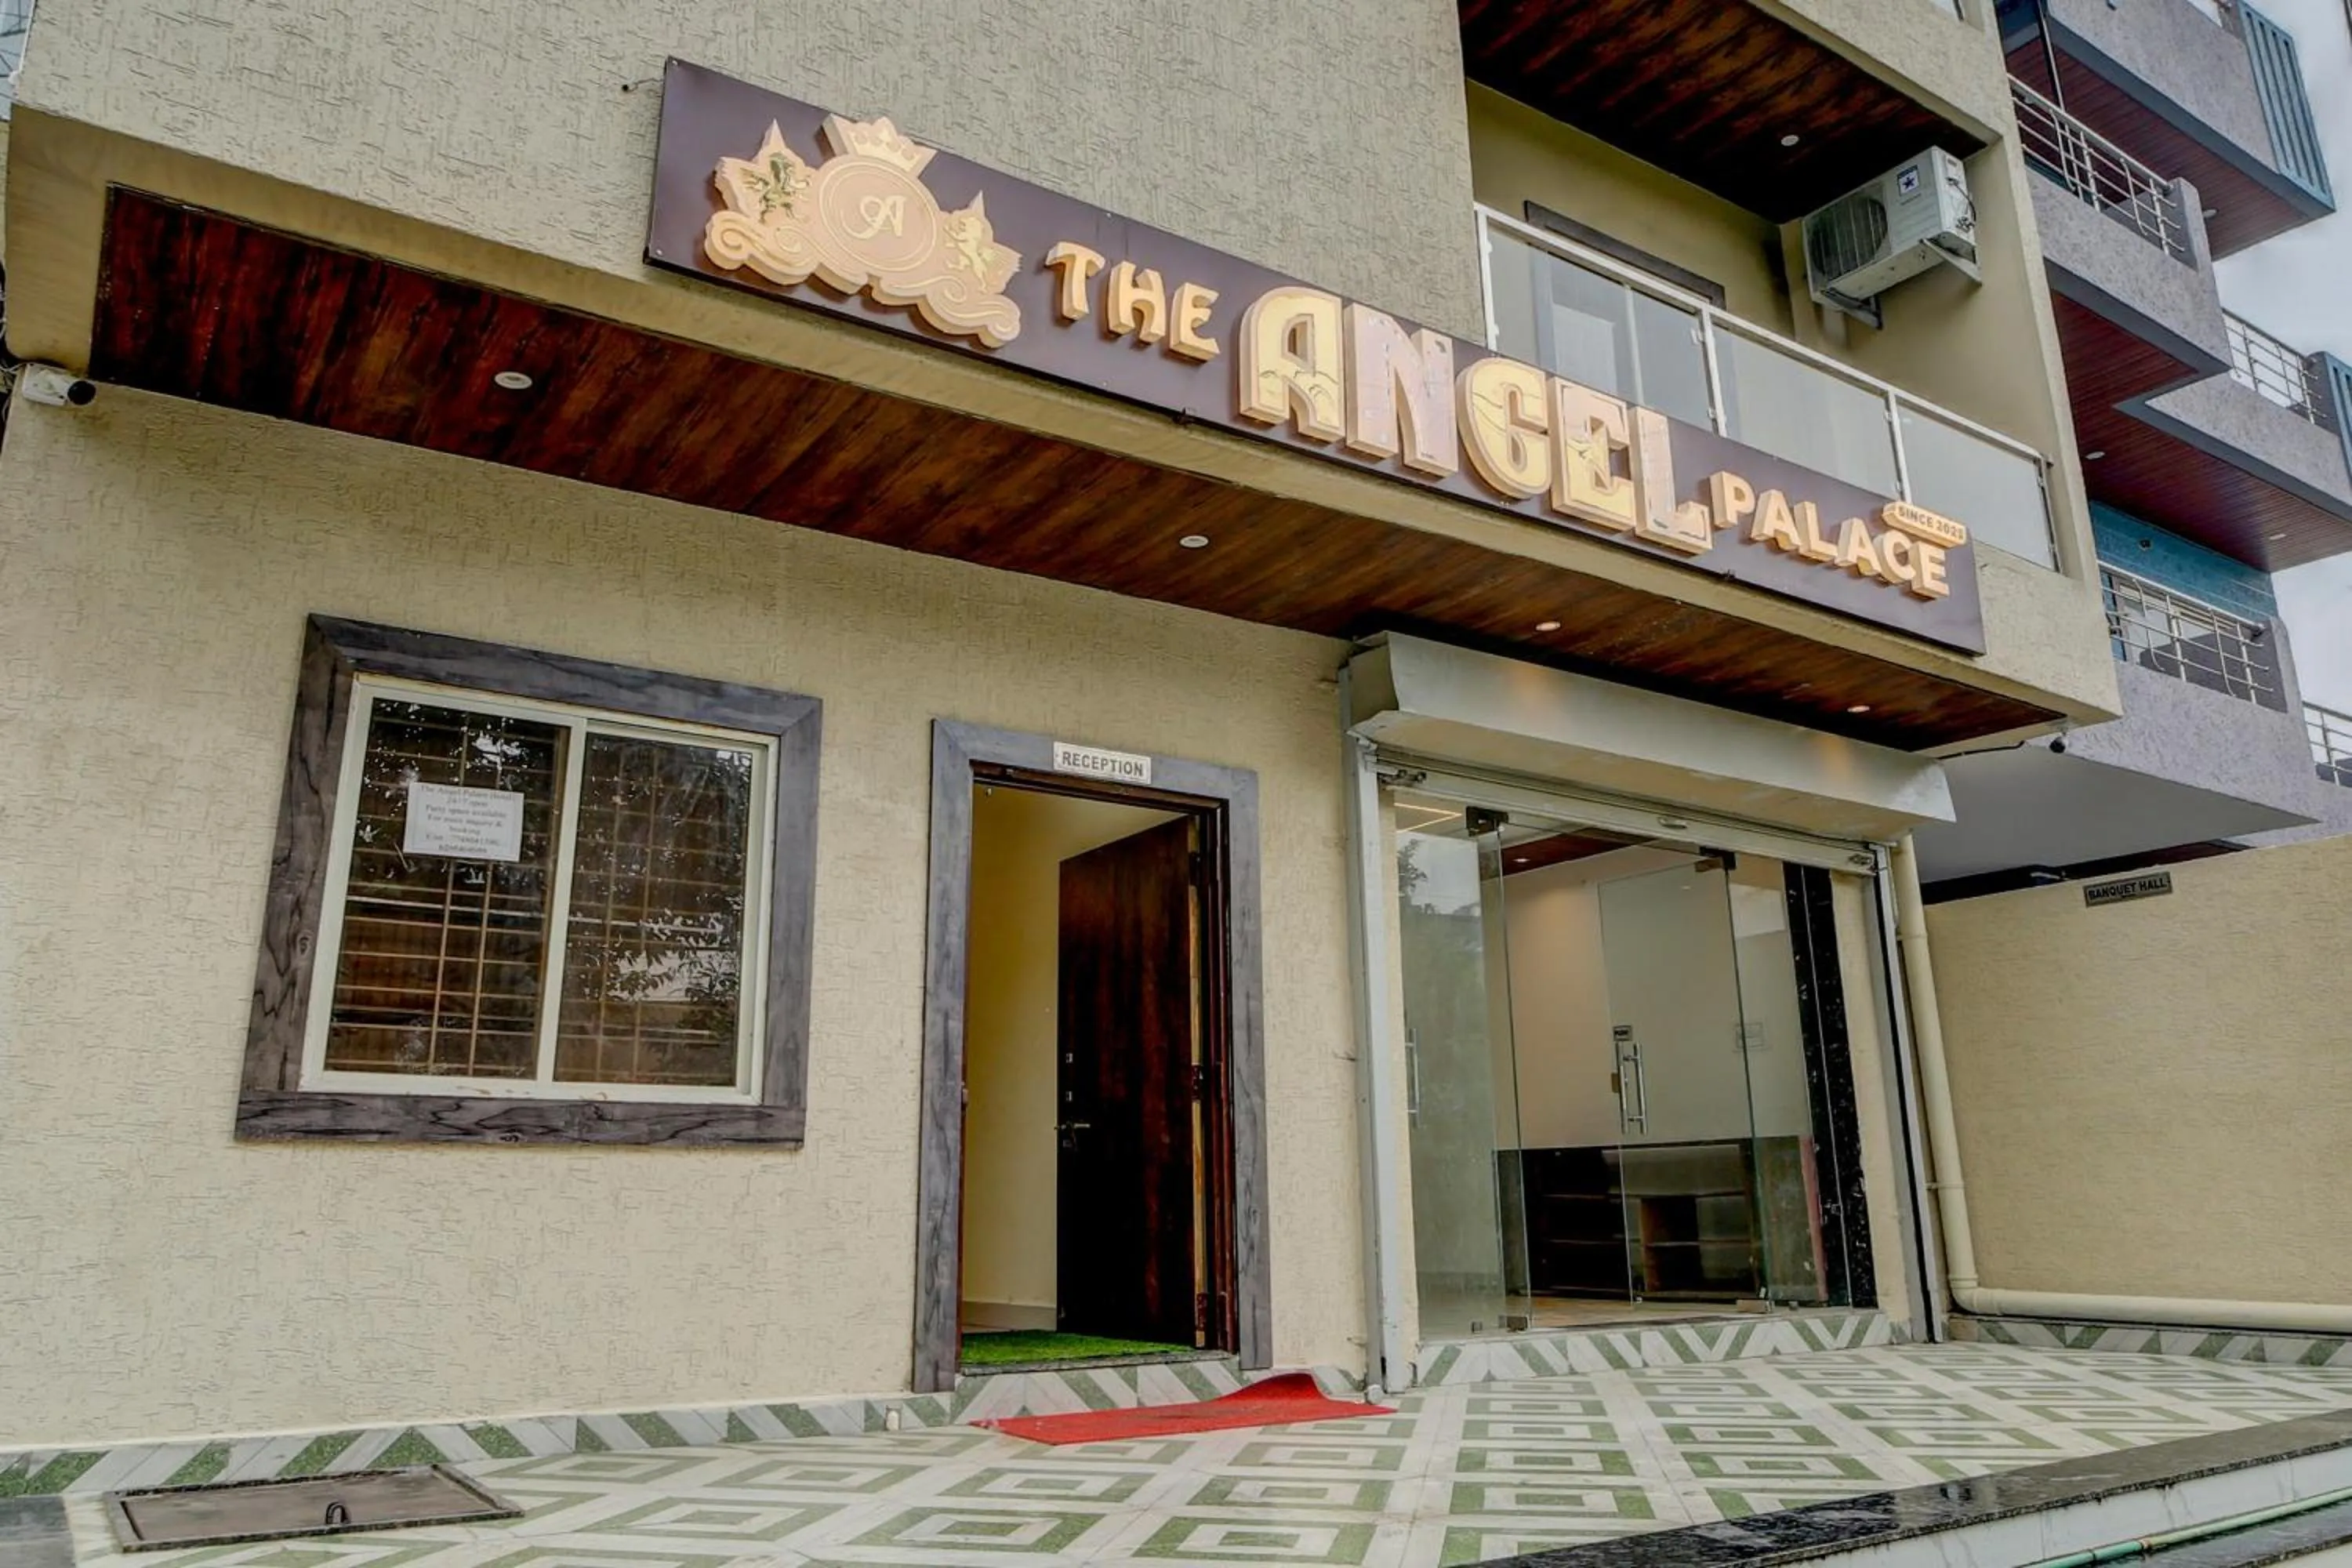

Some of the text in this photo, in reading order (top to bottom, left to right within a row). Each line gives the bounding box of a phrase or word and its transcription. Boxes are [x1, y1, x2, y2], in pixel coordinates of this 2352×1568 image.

[1045, 241, 1950, 600] THE ANGEL PALACE
[1898, 506, 1933, 528] SINCE
[1062, 751, 1143, 776] RECEPTION
[2088, 877, 2168, 901] BANQUET HALL
